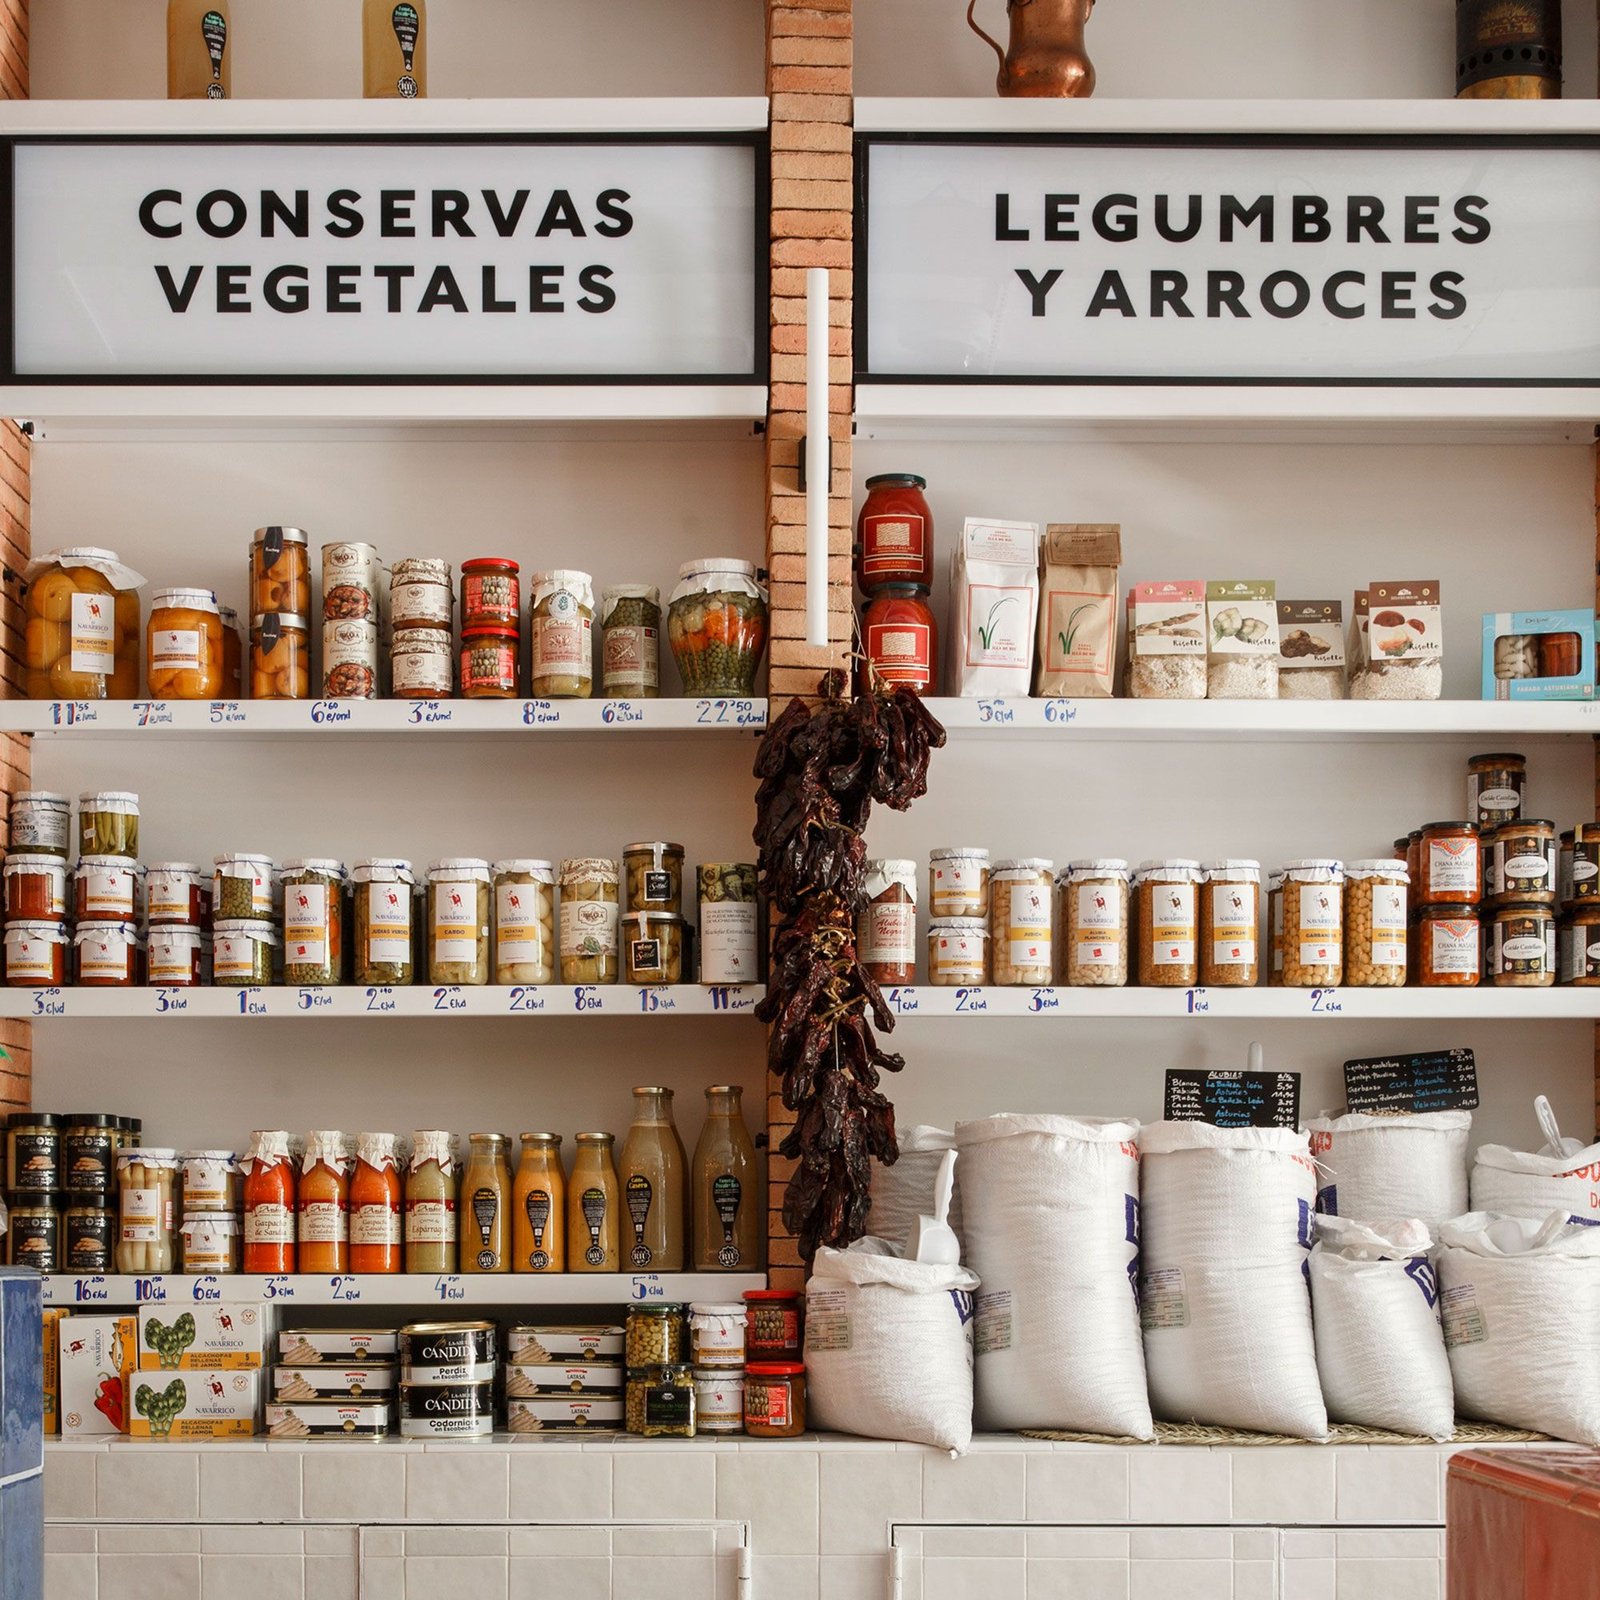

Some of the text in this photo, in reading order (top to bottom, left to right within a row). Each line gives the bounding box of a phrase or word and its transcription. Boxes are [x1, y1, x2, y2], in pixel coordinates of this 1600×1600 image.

[138, 188, 633, 239] CONSERVAS
[995, 192, 1492, 245] LEGUMBRES
[154, 264, 616, 315] VEGETALES
[1014, 268, 1467, 321] Y ARROCES
[439, 1367, 467, 1375] Perdiz
